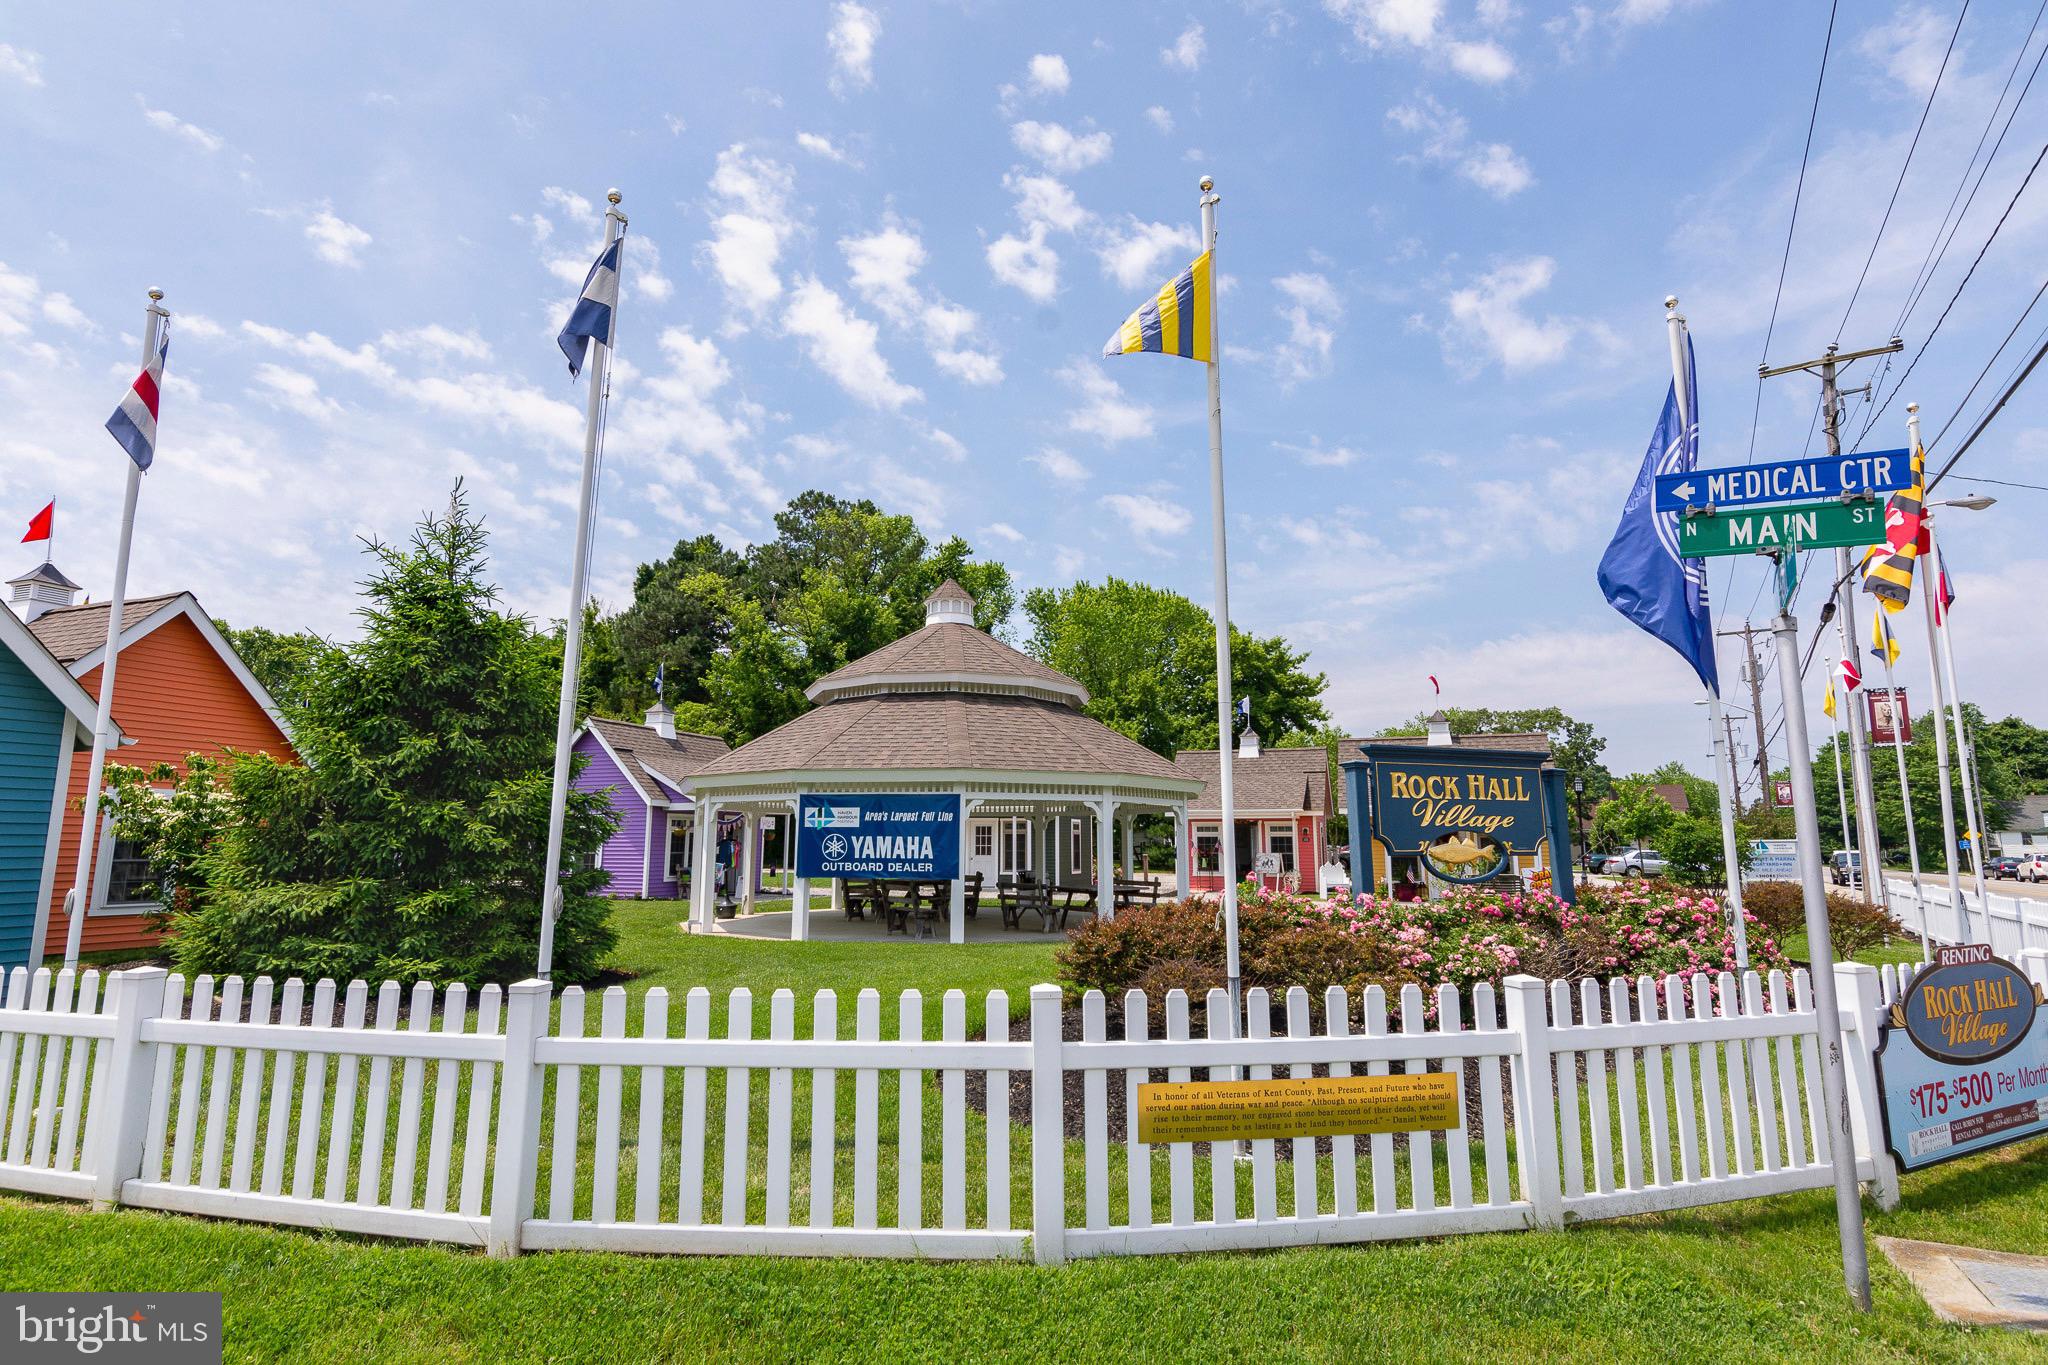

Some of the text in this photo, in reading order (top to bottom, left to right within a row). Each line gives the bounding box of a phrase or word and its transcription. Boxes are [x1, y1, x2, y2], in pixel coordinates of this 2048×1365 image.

[1707, 456, 1892, 501] MEDICAL CTR
[1686, 507, 1875, 546] N MAIN ST
[1389, 771, 1530, 801] ROCK HALL
[864, 811, 954, 822] Area's Largest Full Line
[1411, 798, 1515, 834] Village
[851, 836, 934, 860] YAMAHA
[822, 862, 933, 872] OUTBOARD DEALER
[1942, 946, 1990, 966] RENTING
[1922, 976, 2018, 1019] ROCK HALL
[1941, 1011, 2008, 1047] Village
[1997, 1072, 2016, 1094] Per
[1219, 1102, 1245, 1110] during
[1360, 1095, 1398, 1104] sculptured
